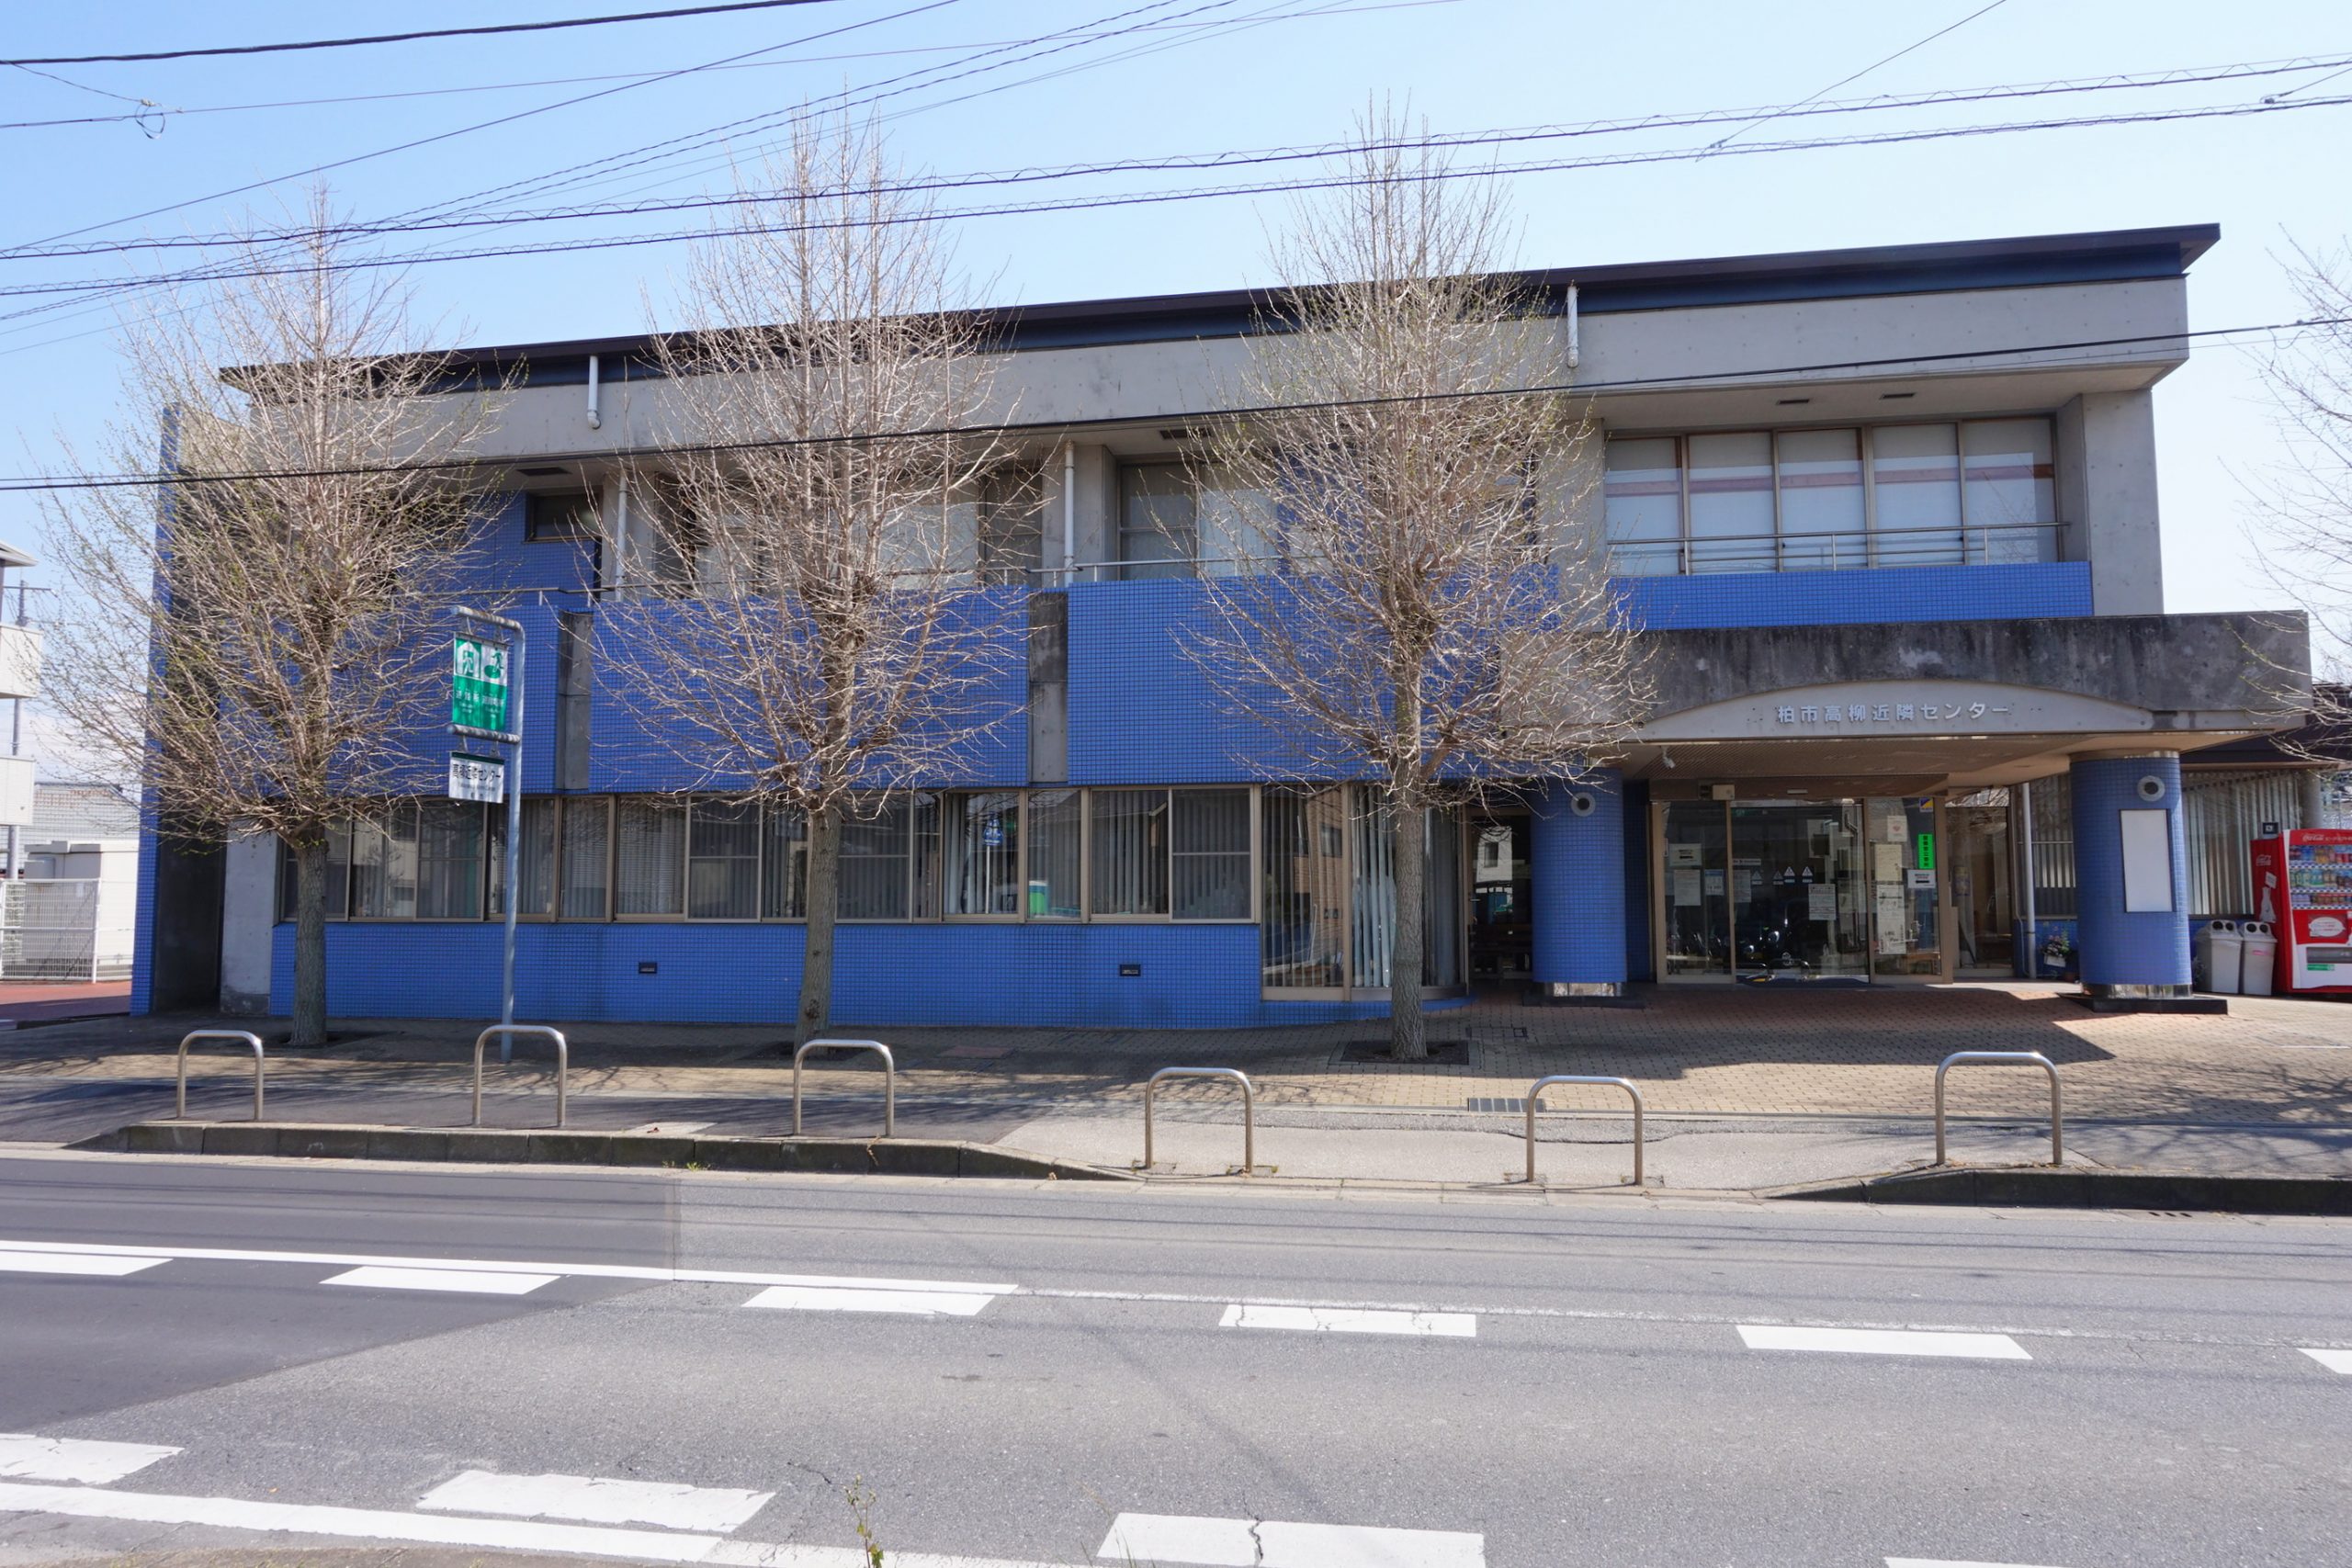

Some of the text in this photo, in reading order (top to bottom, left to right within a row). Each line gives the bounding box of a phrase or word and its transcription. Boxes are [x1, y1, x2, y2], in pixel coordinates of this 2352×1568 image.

[1778, 702, 2008, 724] 柏市高柳近隣センター
